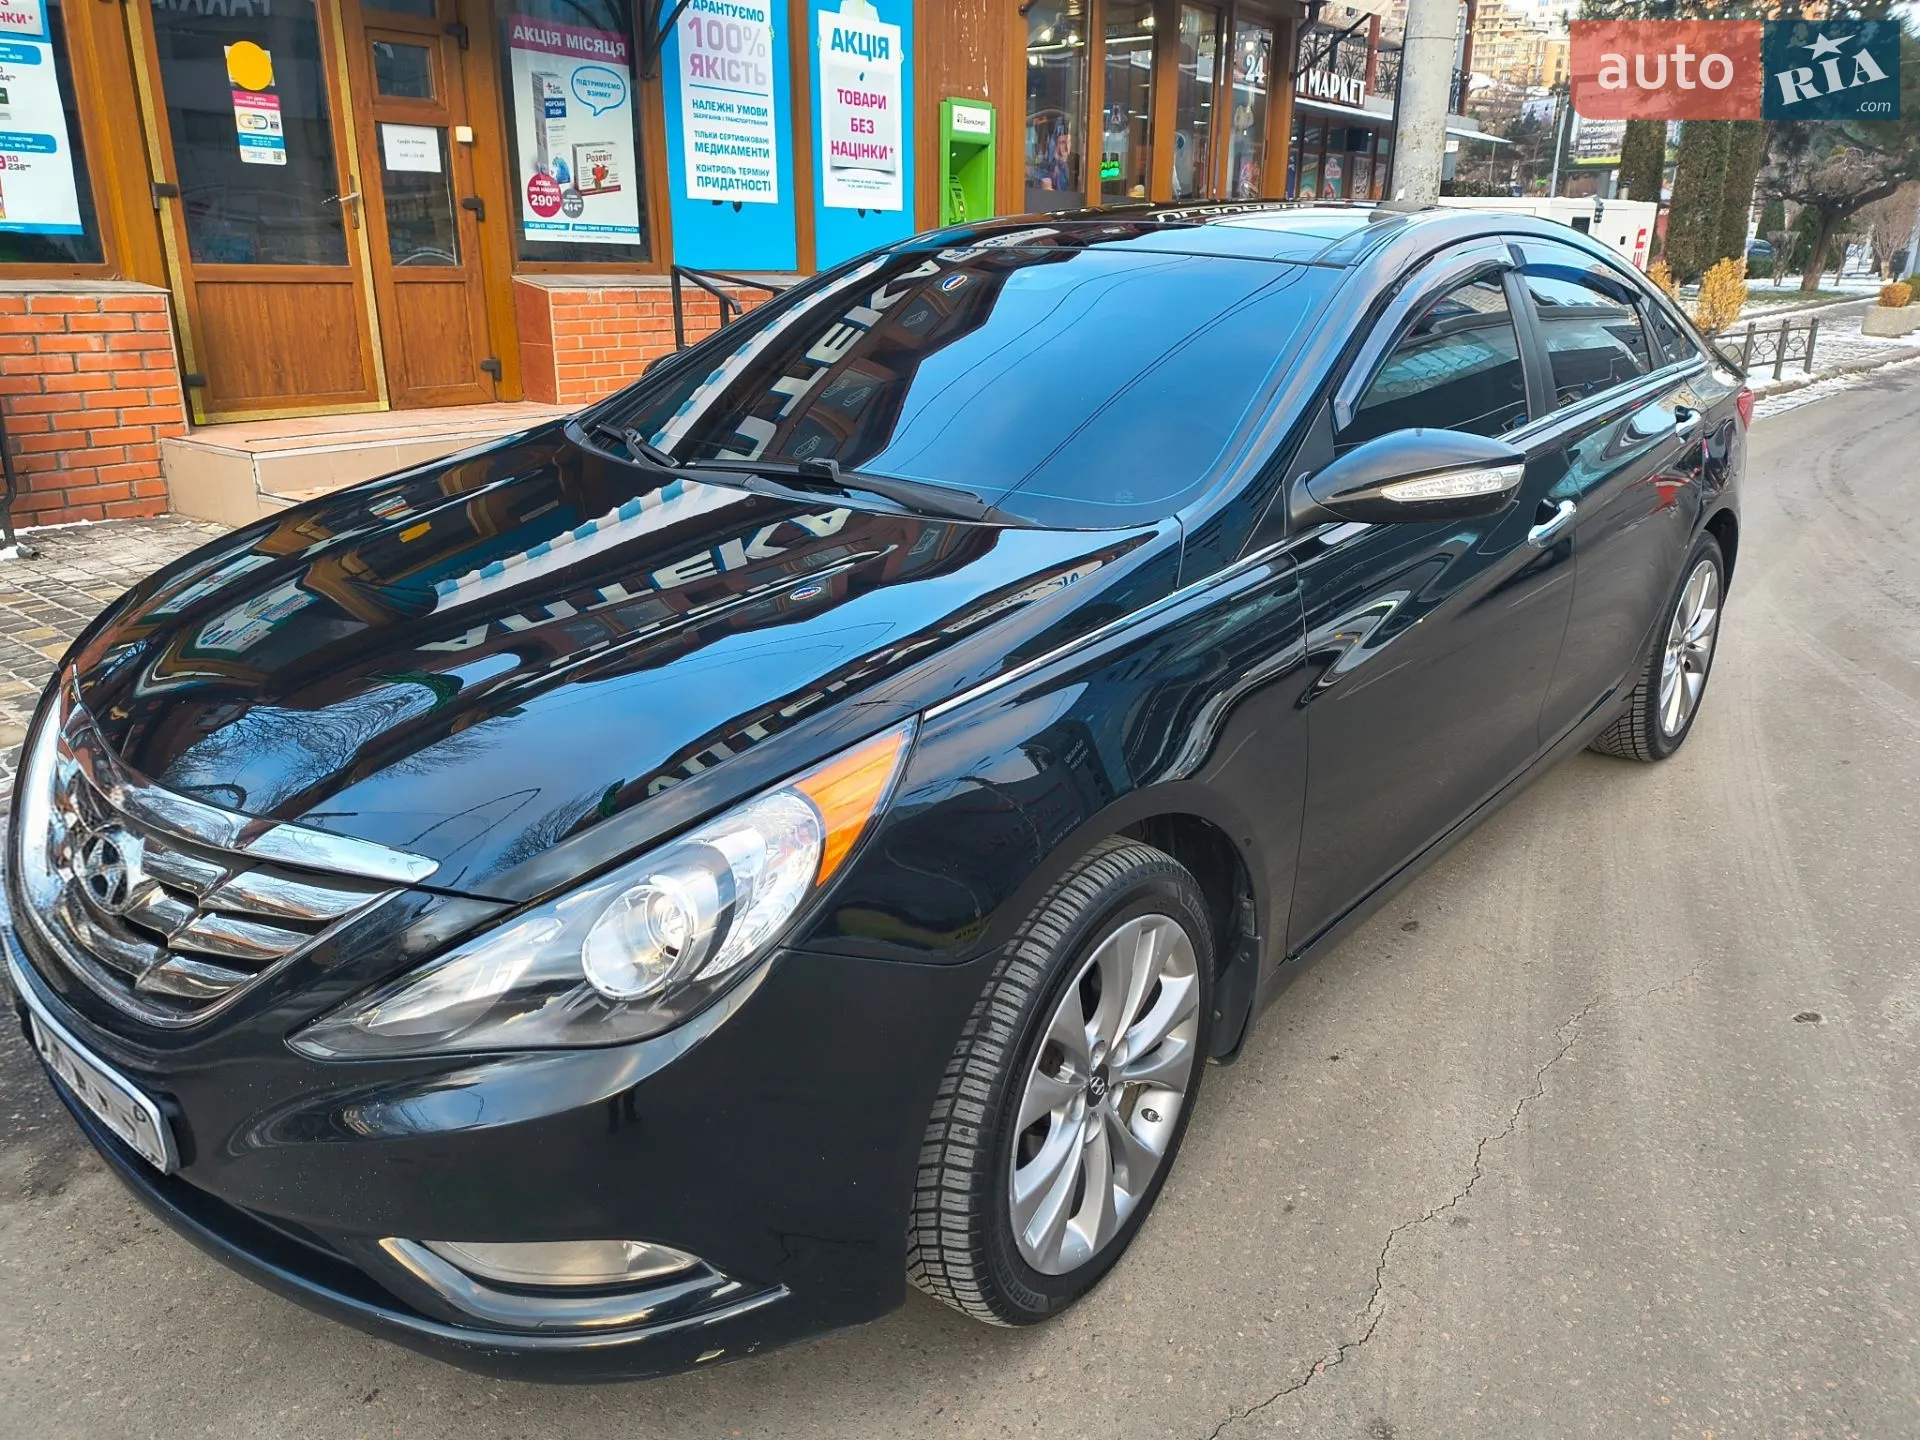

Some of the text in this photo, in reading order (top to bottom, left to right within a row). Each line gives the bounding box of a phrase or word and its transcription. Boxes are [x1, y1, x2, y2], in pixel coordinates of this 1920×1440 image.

[513, 25, 626, 58] АКЦІЯ МІСЯЦЯ
[688, 17, 766, 58] 100%
[831, 27, 890, 62] АКЦІЯ
[689, 53, 767, 86] ЯКІСТЬ
[1245, 55, 1266, 84] 24
[575, 78, 621, 90] ПІДТРИМУЄМО
[1308, 67, 1367, 105] МАРКЕТ
[586, 89, 611, 99] ВЗИМКУ
[837, 88, 887, 110] ТОВАРИ
[692, 98, 768, 117] НАЛЕЖНІ УМОВИ
[850, 117, 875, 134] БЕЗ
[694, 130, 770, 144] ТІЛЬКИ СЕРТИФІКОВАНІ
[695, 142, 770, 158] МЕДИКАМЕНТИ
[696, 164, 770, 177] КОНТРОЛЬ ТЕРМІНУ
[697, 175, 771, 192] ПРИДАТНОСТІ
